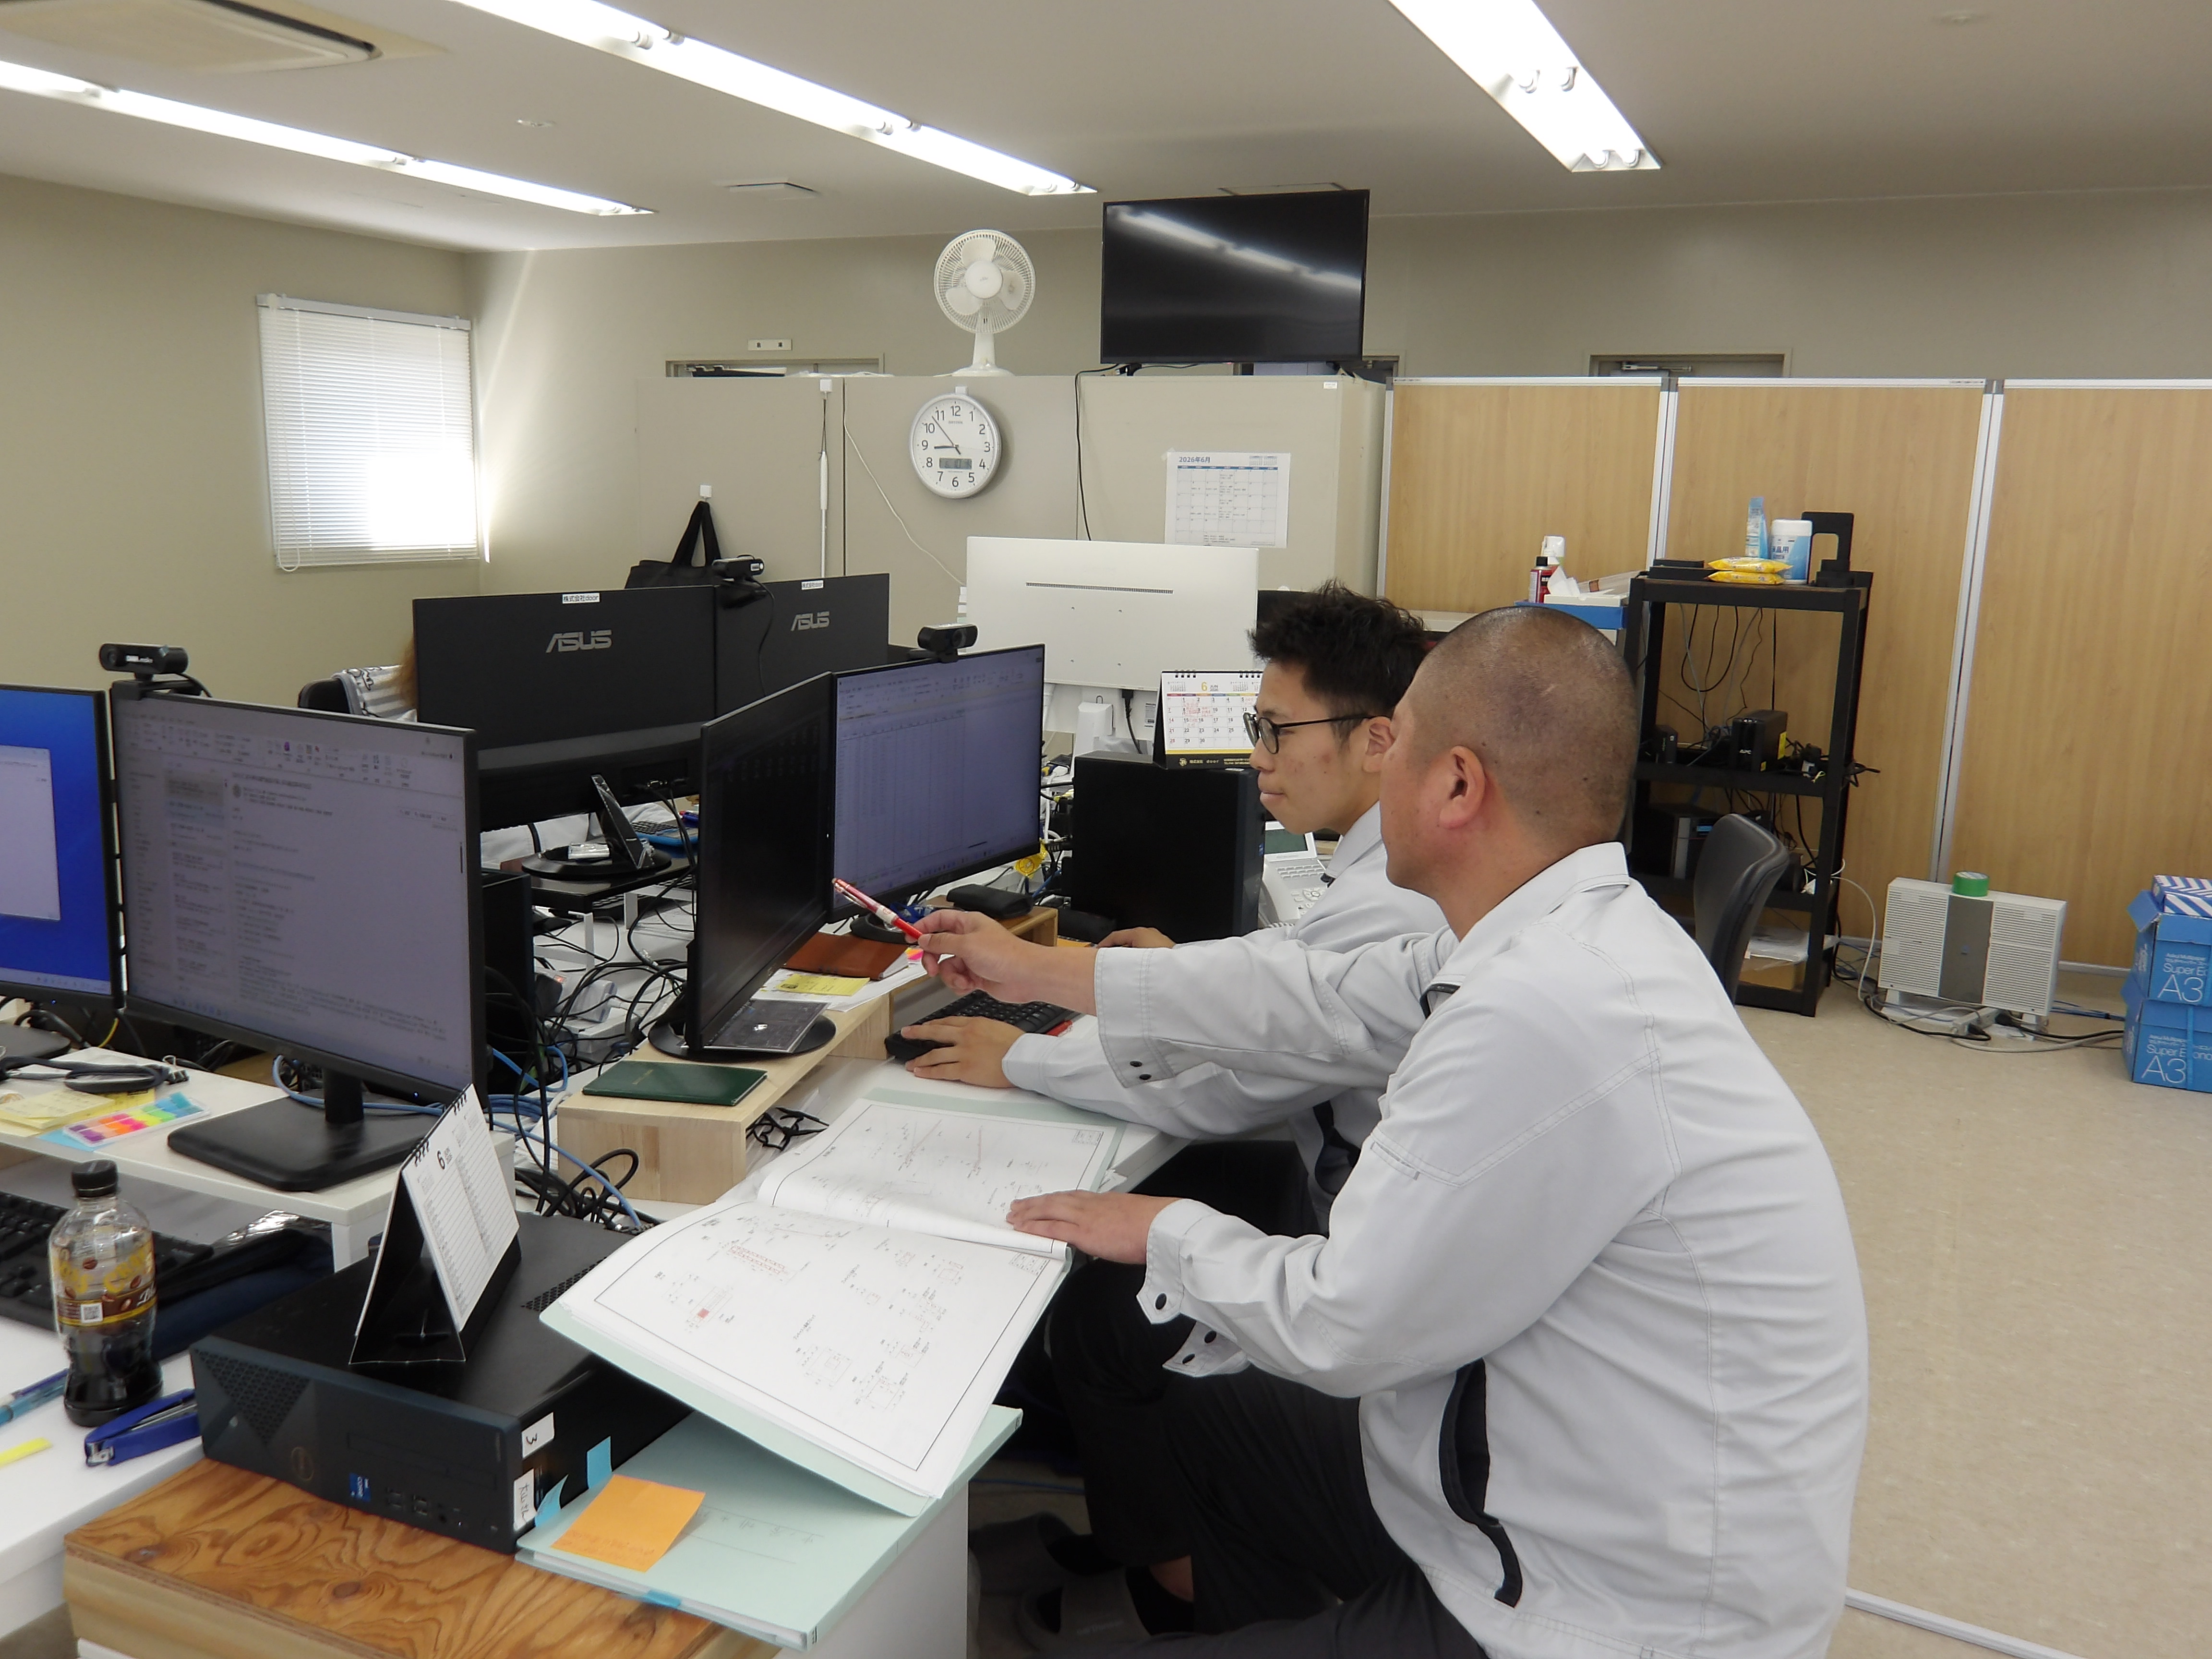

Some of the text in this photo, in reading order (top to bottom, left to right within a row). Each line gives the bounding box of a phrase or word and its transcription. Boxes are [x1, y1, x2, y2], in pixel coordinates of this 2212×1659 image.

[936, 410, 944, 421] 11
[950, 406, 961, 416] 12
[969, 411, 973, 421] 1
[924, 423, 935, 433] 10
[979, 424, 985, 434] 2
[922, 440, 928, 450] 9
[984, 442, 990, 452] 3
[926, 457, 933, 468] 8
[979, 459, 986, 469] 4
[937, 471, 943, 481] 7
[968, 472, 974, 483] 5
[952, 477, 959, 487] 6
[791, 611, 830, 631] ASUS
[545, 629, 612, 653] ASUS
[1202, 682, 1207, 691] 6
[2163, 962, 2195, 975] Super
[2157, 974, 2203, 1003] A3
[2147, 1044, 2177, 1057] Super
[2141, 1056, 2186, 1083] A3
[437, 1150, 445, 1170] 6
[526, 1433, 537, 1445] 3
